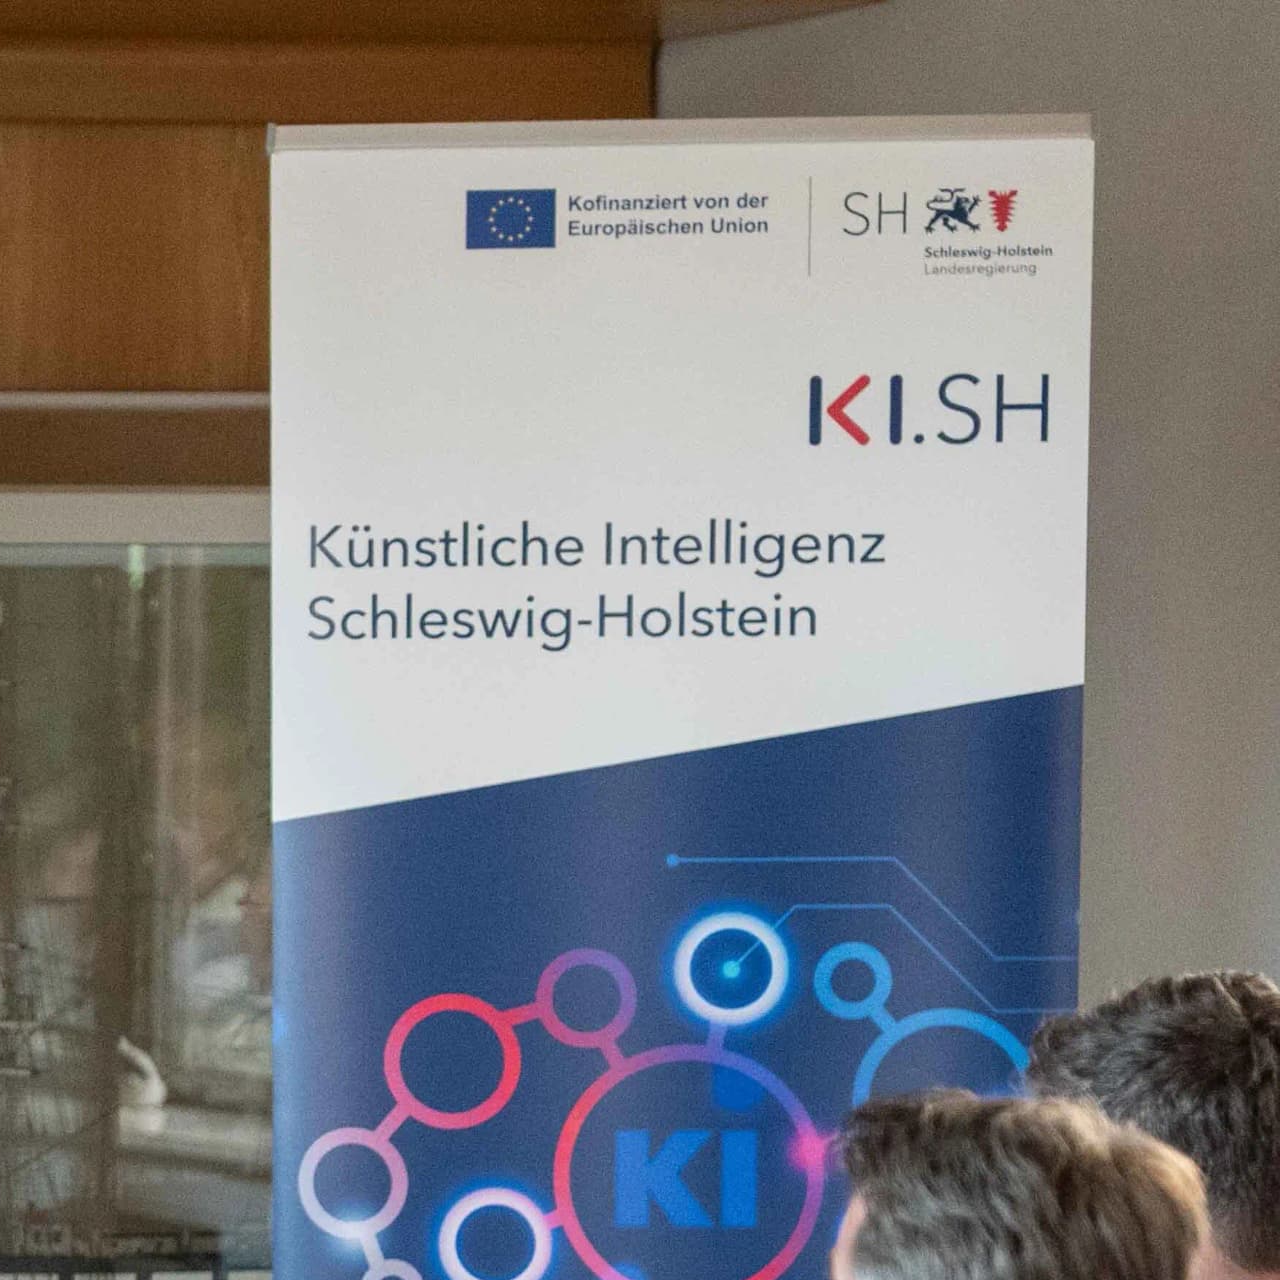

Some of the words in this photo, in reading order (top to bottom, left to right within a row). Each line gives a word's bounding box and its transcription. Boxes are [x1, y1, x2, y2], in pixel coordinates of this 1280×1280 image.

[568, 194, 687, 212] Kofinanziert
[693, 197, 729, 210] von
[736, 193, 769, 209] der
[842, 191, 907, 236] SH
[568, 218, 704, 239] Europäischen
[711, 216, 769, 234] Union
[924, 245, 1053, 263] Schleswig-Holstein
[924, 262, 1037, 277] Landesregierung
[808, 373, 1050, 446] KI.SH
[309, 520, 585, 568] Künstliche
[604, 519, 886, 578] Intelligenz
[307, 592, 818, 652] Schleswig-Holstein
[613, 1128, 758, 1230] KI
